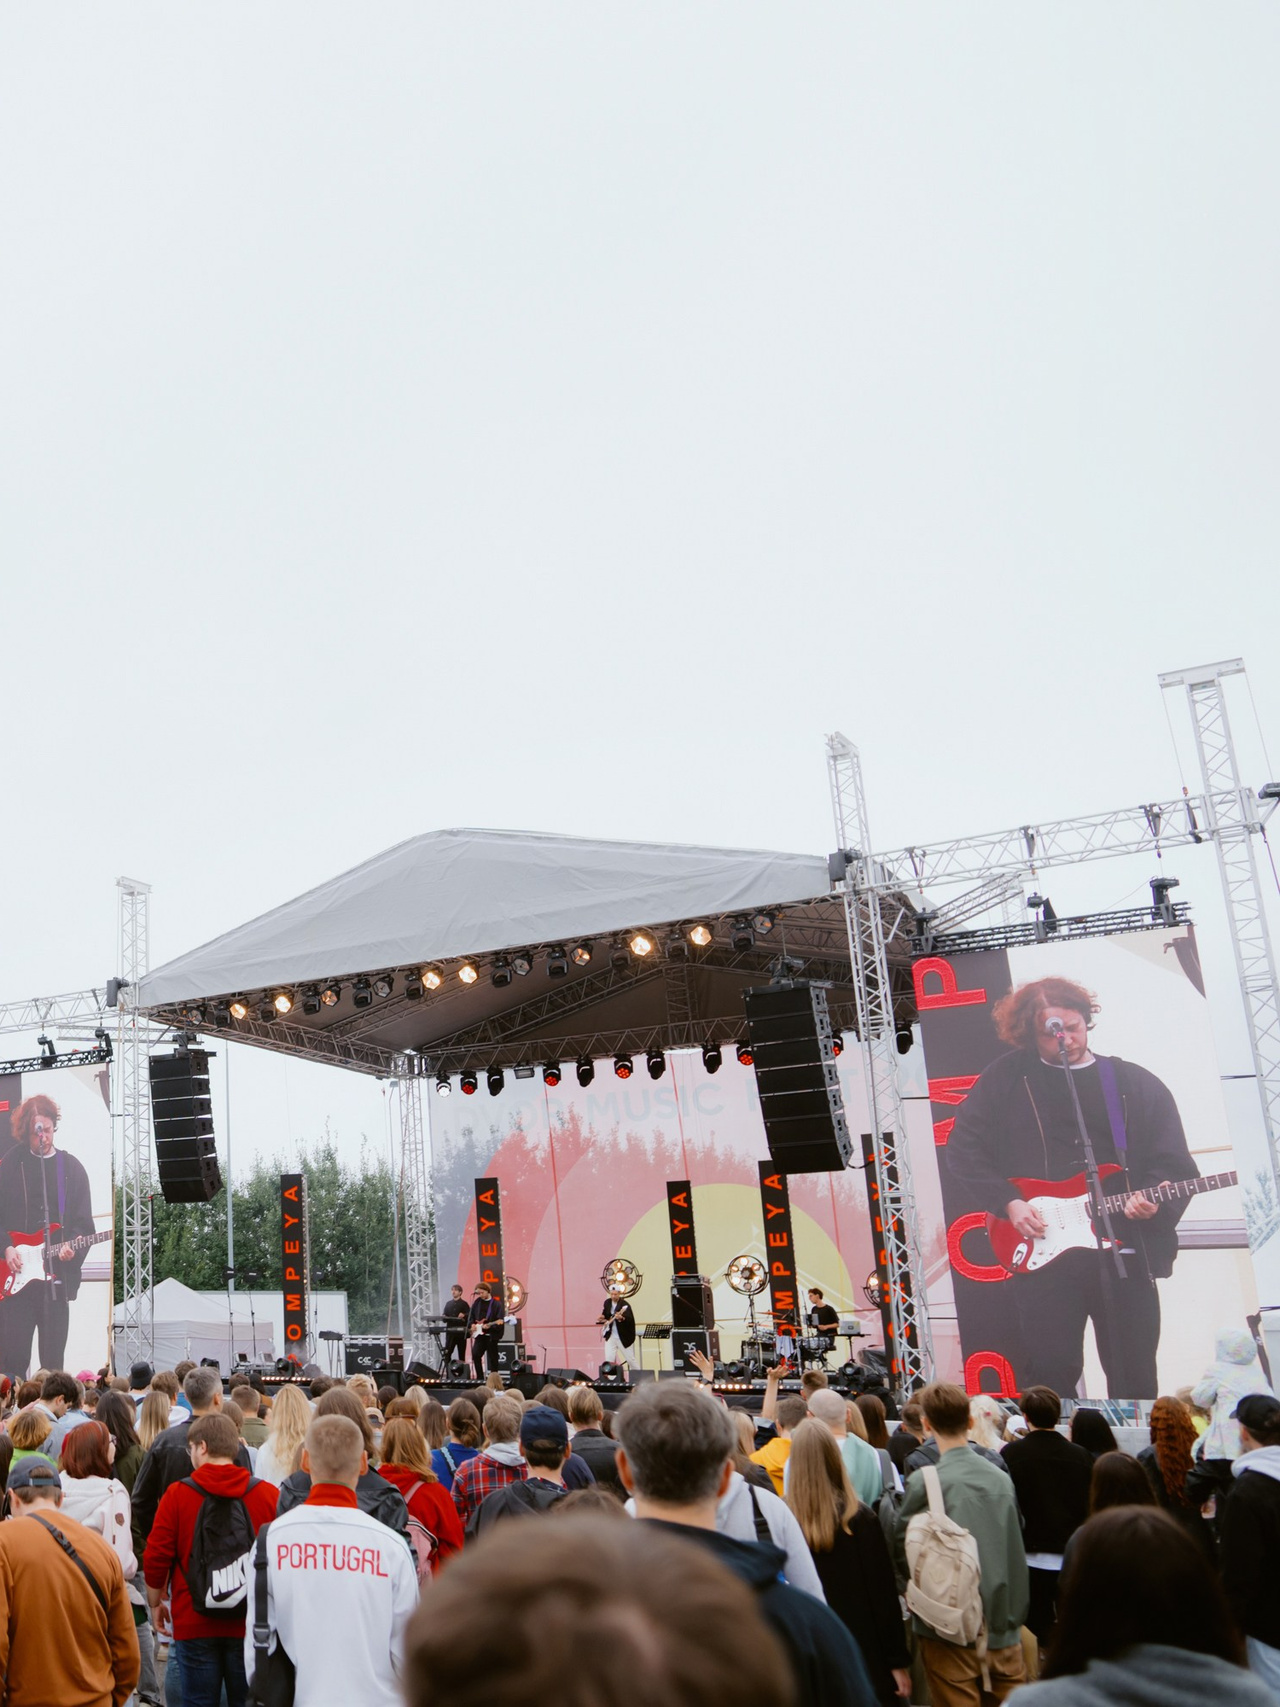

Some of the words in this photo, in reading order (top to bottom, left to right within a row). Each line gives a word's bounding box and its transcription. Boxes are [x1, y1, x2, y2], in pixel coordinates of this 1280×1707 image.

[586, 1081, 725, 1124] MUSIC
[212, 1551, 249, 1597] NIK
[277, 1543, 388, 1577] PORTUGAL
